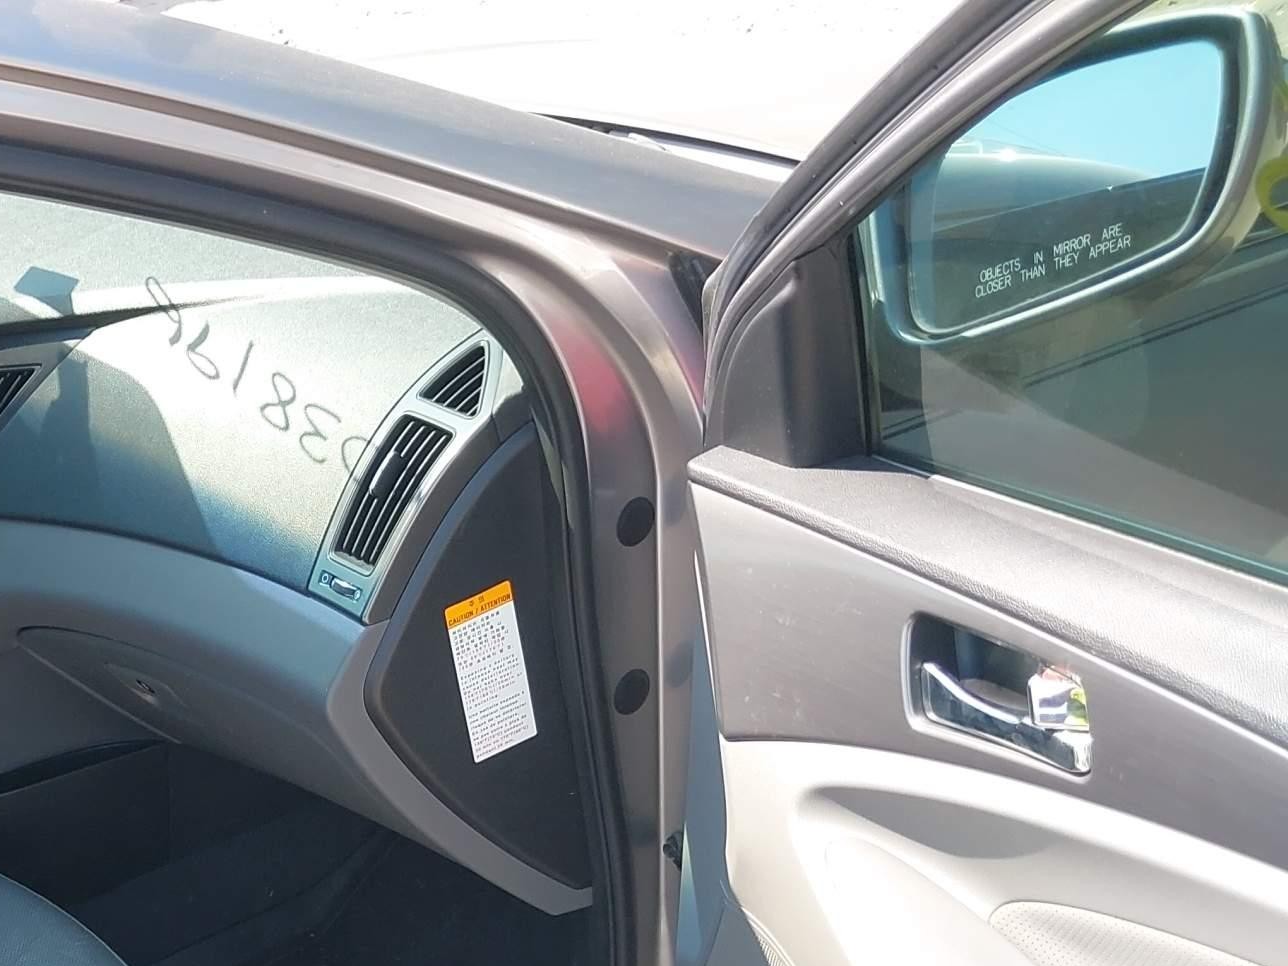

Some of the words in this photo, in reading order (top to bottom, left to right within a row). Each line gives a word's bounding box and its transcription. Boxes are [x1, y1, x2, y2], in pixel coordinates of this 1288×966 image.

[975, 275, 1012, 298] CLOSER
[1020, 263, 1046, 282] THAN
[1053, 251, 1079, 270] THEY
[1089, 234, 1131, 260] APPEAR
[979, 257, 1021, 283] OBJECTS
[1033, 250, 1044, 265] IN
[1053, 233, 1091, 257] MIRROR
[1101, 222, 1123, 241] ARE
[449, 610, 474, 626] CAUTION
[480, 593, 511, 612] ATTENTION
